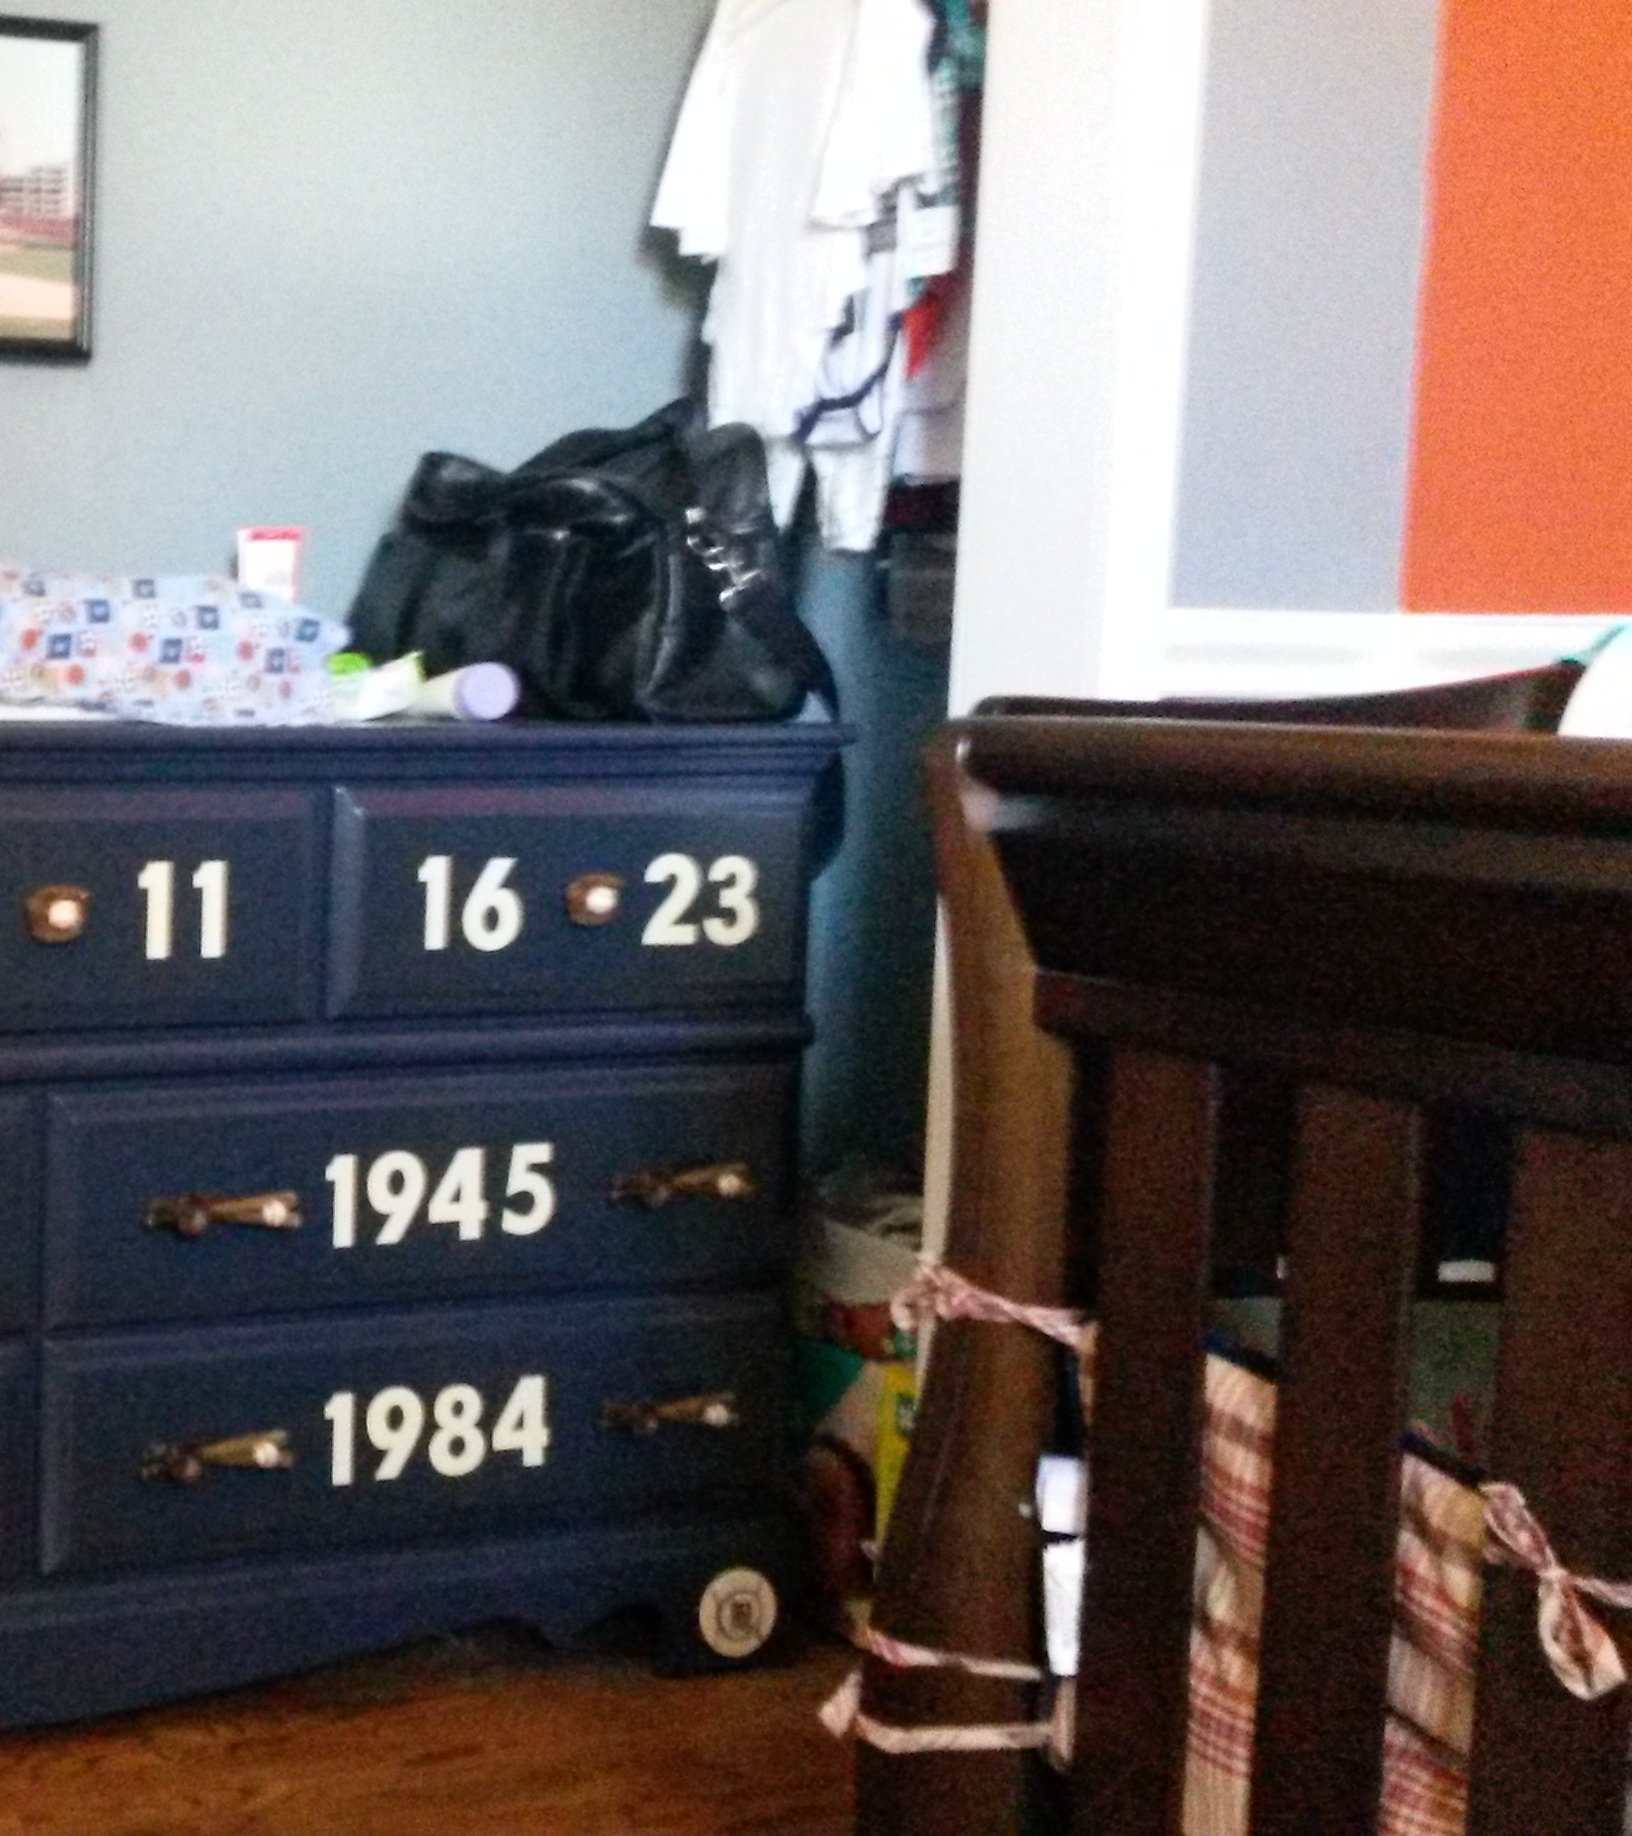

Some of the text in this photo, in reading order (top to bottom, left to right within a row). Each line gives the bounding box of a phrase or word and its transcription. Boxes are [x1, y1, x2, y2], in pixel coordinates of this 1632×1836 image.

[137, 860, 227, 960] 11
[417, 855, 523, 952] 16
[641, 853, 758, 946] 23
[325, 1143, 555, 1248] 1945
[324, 1376, 549, 1486] 1984
